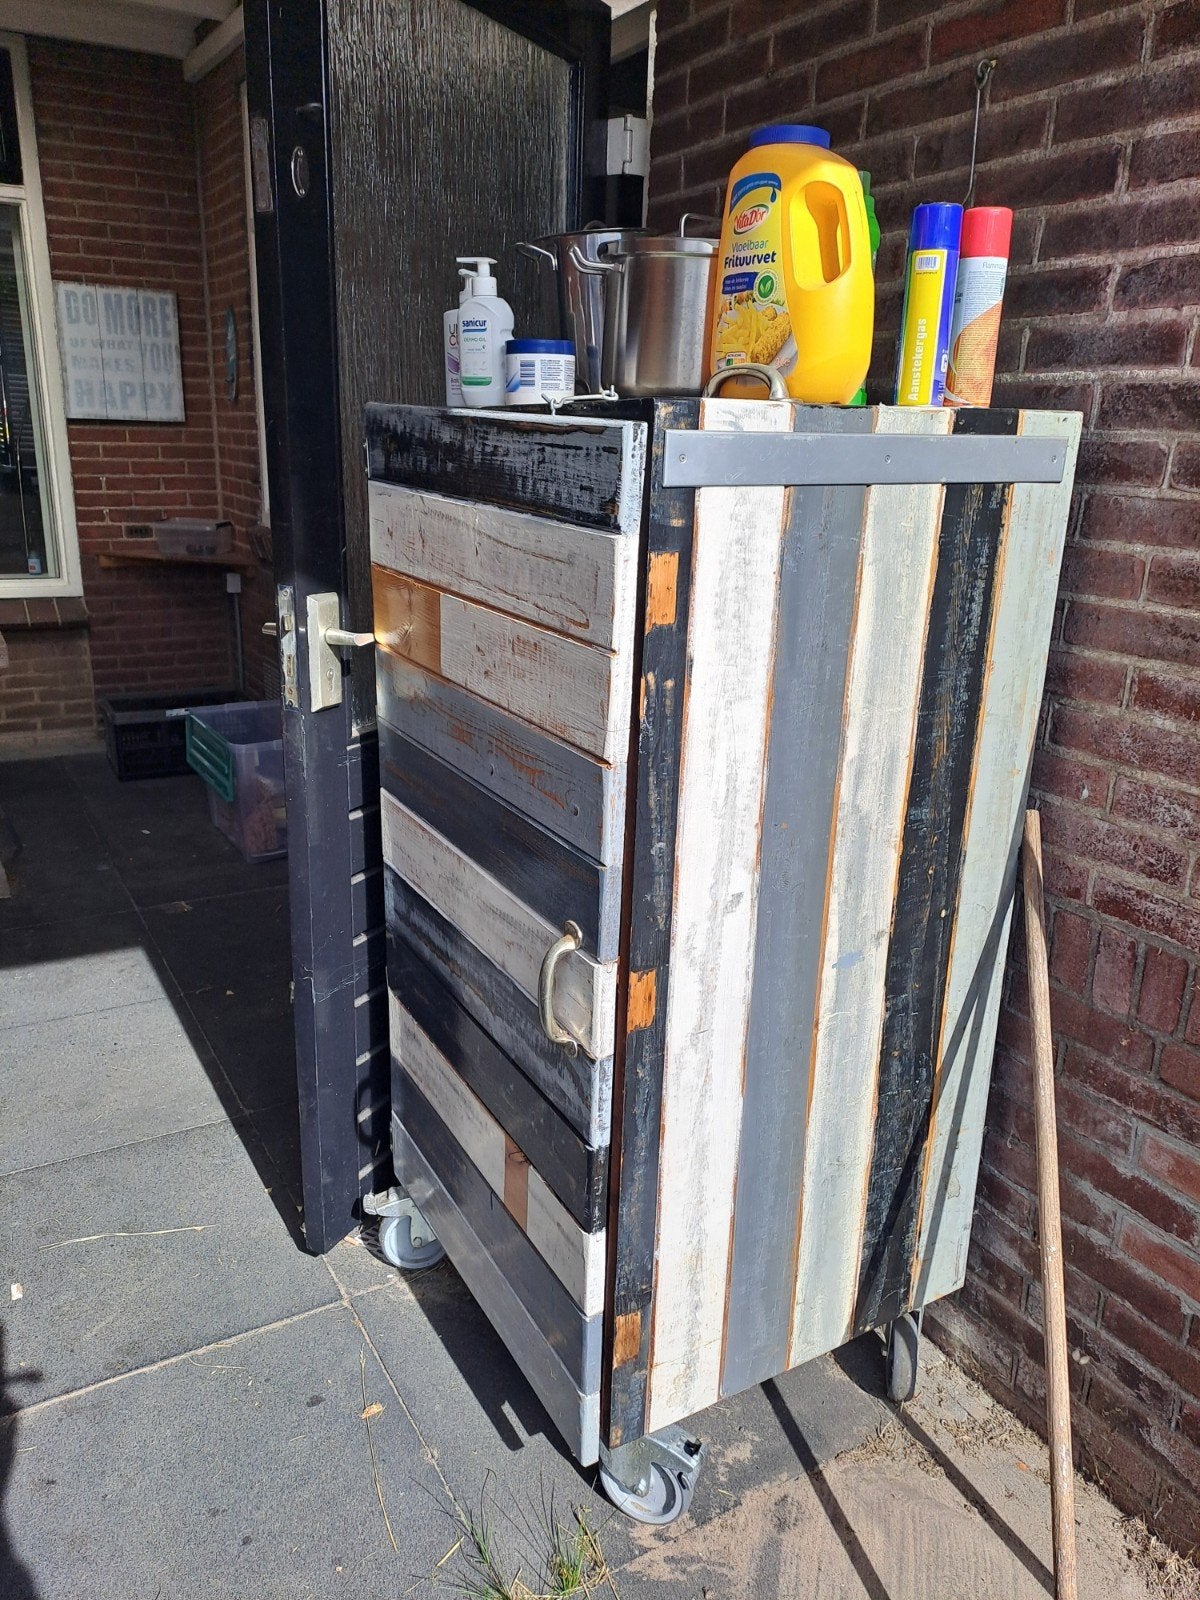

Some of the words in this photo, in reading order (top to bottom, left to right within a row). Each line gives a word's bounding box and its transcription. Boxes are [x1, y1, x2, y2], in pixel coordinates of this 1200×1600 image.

[731, 240, 769, 253] Vloeibaar
[723, 250, 777, 269] Frituurvet
[64, 290, 97, 325] DO
[102, 293, 172, 338] MORE
[462, 317, 487, 328] sanicur
[91, 339, 135, 351] WHAT
[71, 355, 136, 373] MAKES
[141, 342, 174, 375] YOU
[907, 318, 928, 402] Aanstekergas
[75, 378, 175, 411] HAPPY
